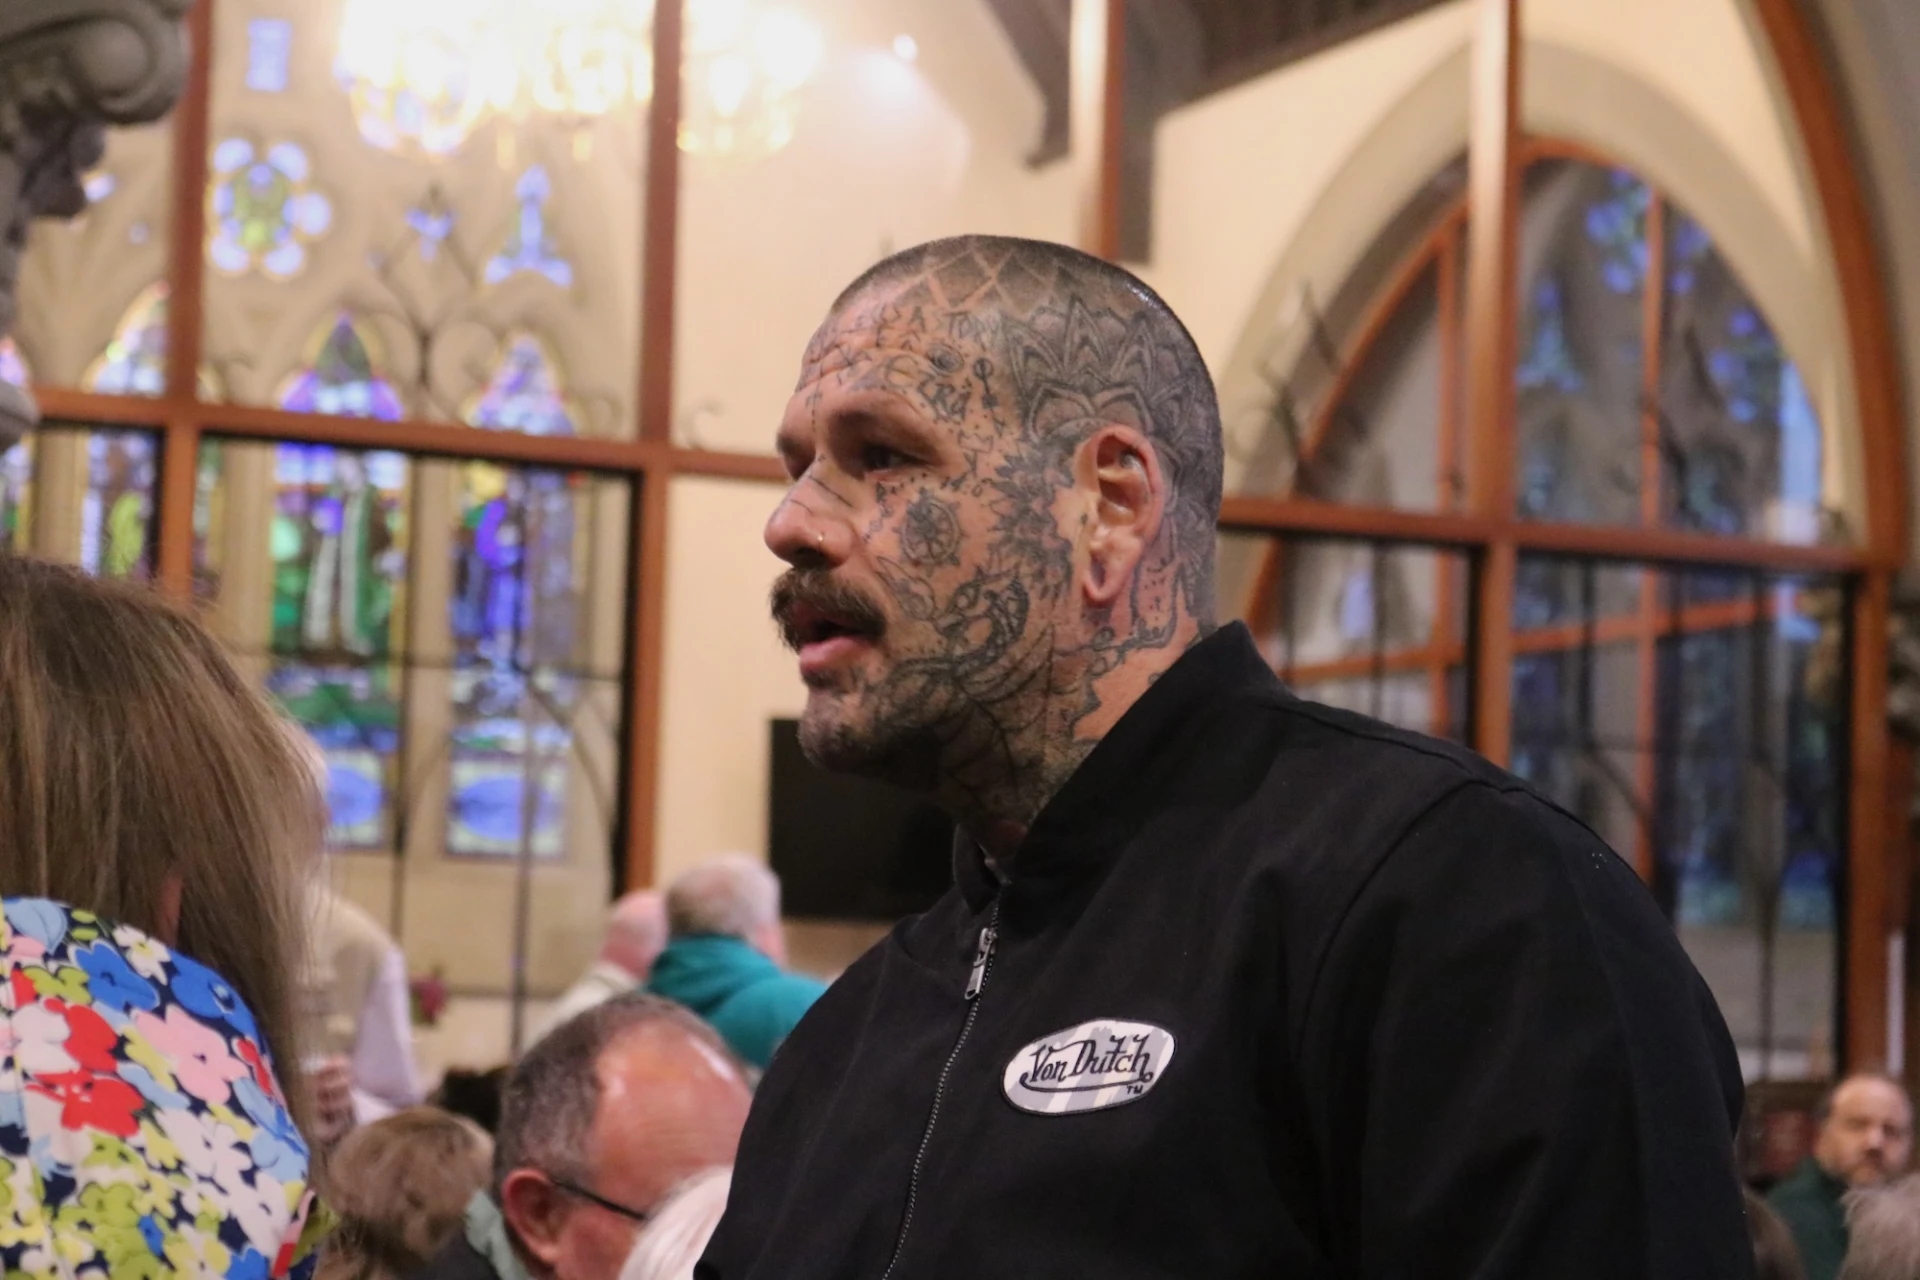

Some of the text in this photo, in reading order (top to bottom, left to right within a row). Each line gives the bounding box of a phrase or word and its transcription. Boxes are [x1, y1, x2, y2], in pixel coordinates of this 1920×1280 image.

[1029, 1034, 1153, 1082] Von Dutch
[1126, 1085, 1143, 1095] TM
